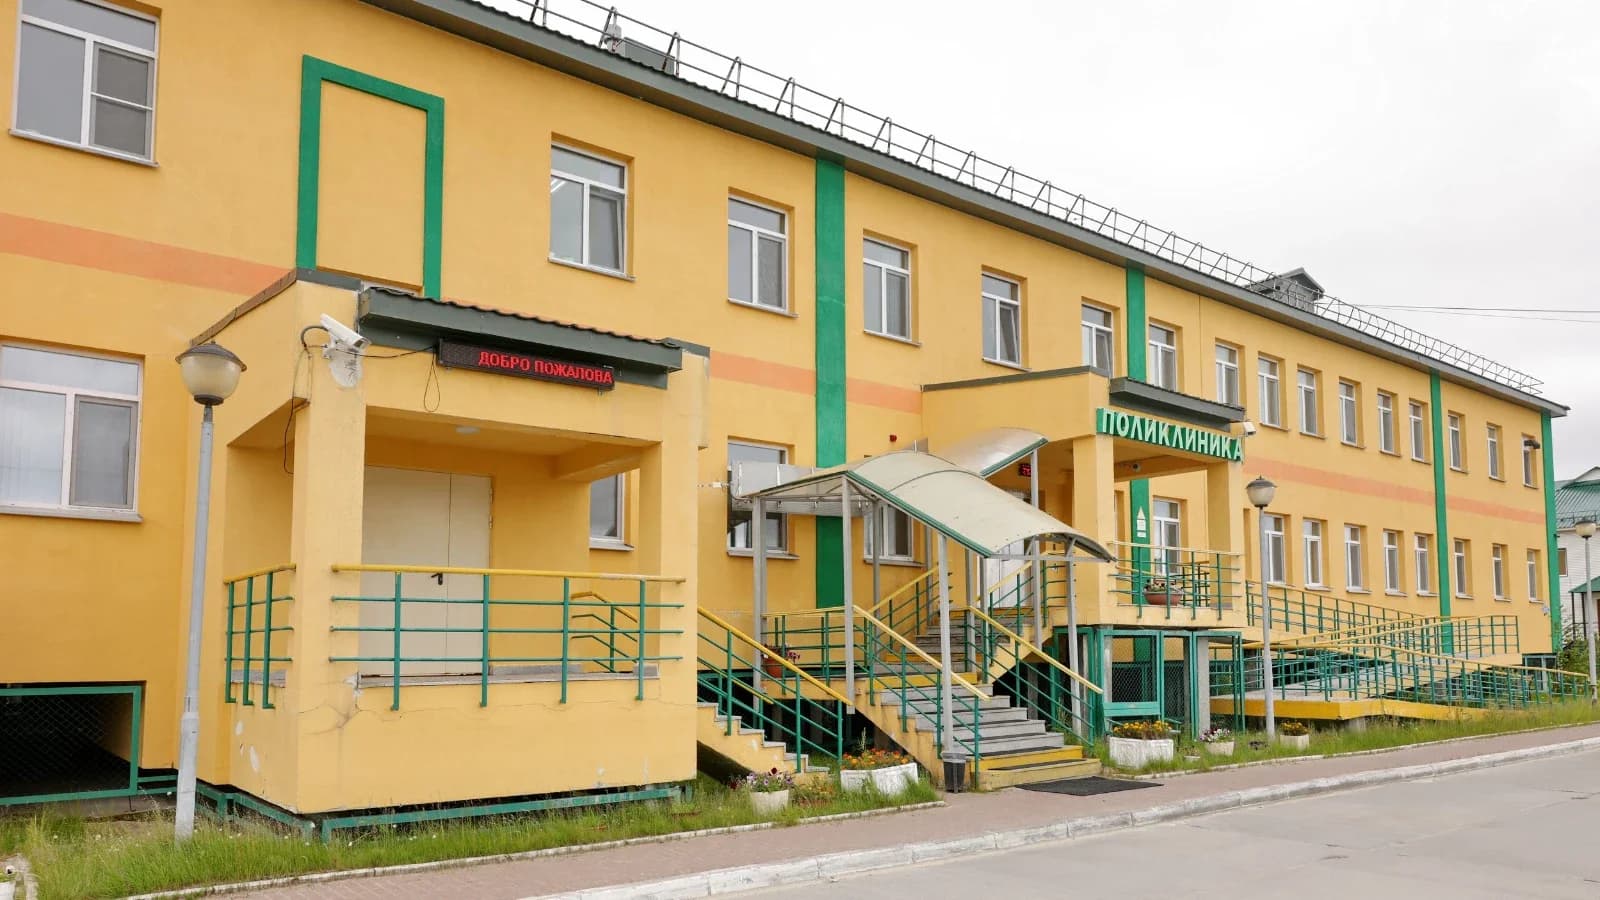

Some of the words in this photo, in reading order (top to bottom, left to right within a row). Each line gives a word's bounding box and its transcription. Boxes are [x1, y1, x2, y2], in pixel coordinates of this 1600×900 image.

[478, 351, 530, 371] ДОБРО
[534, 360, 613, 383] ПОЖАЛОВА
[1102, 409, 1242, 461] ПОЛИКЛИНИКА
